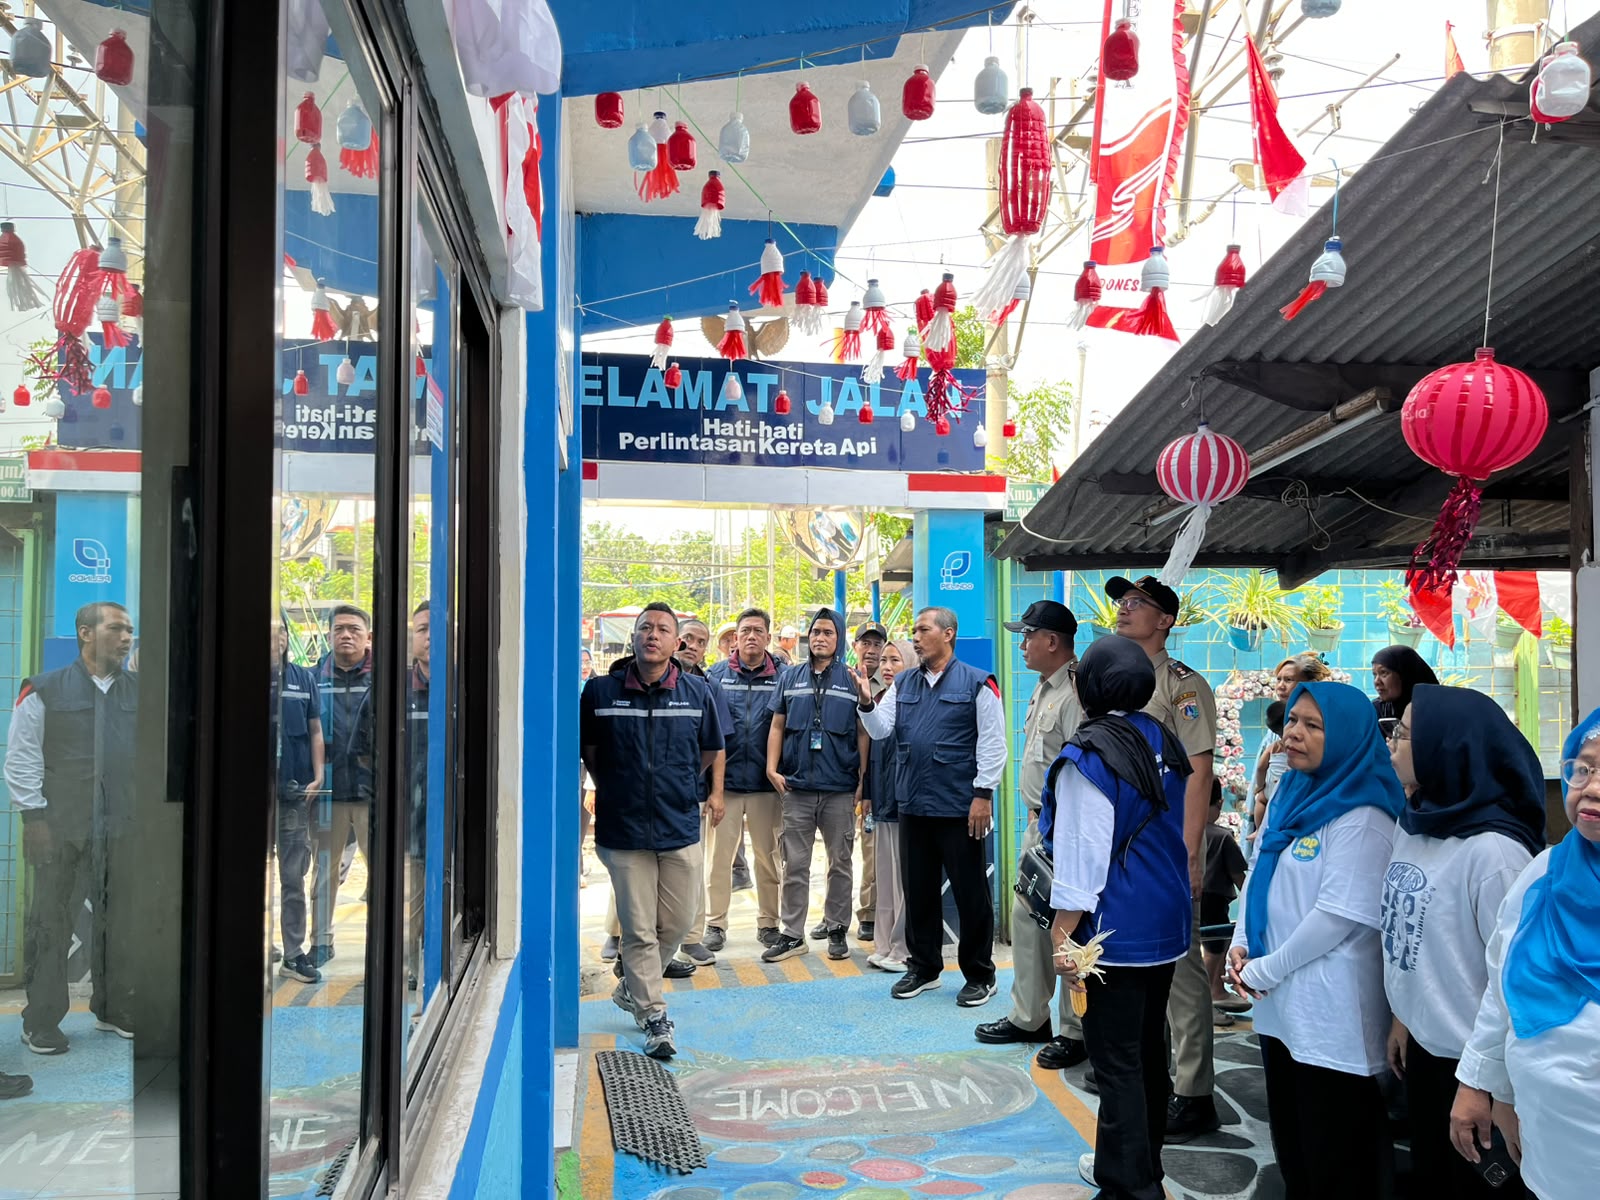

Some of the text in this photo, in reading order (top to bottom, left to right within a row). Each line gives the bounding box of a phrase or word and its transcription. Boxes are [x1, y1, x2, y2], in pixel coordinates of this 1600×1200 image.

[582, 365, 779, 413] ELAMAT
[619, 432, 877, 457] Perlintasan Kereta Api
[703, 418, 803, 440] Hati-hati
[709, 1075, 994, 1121] WELCOME
